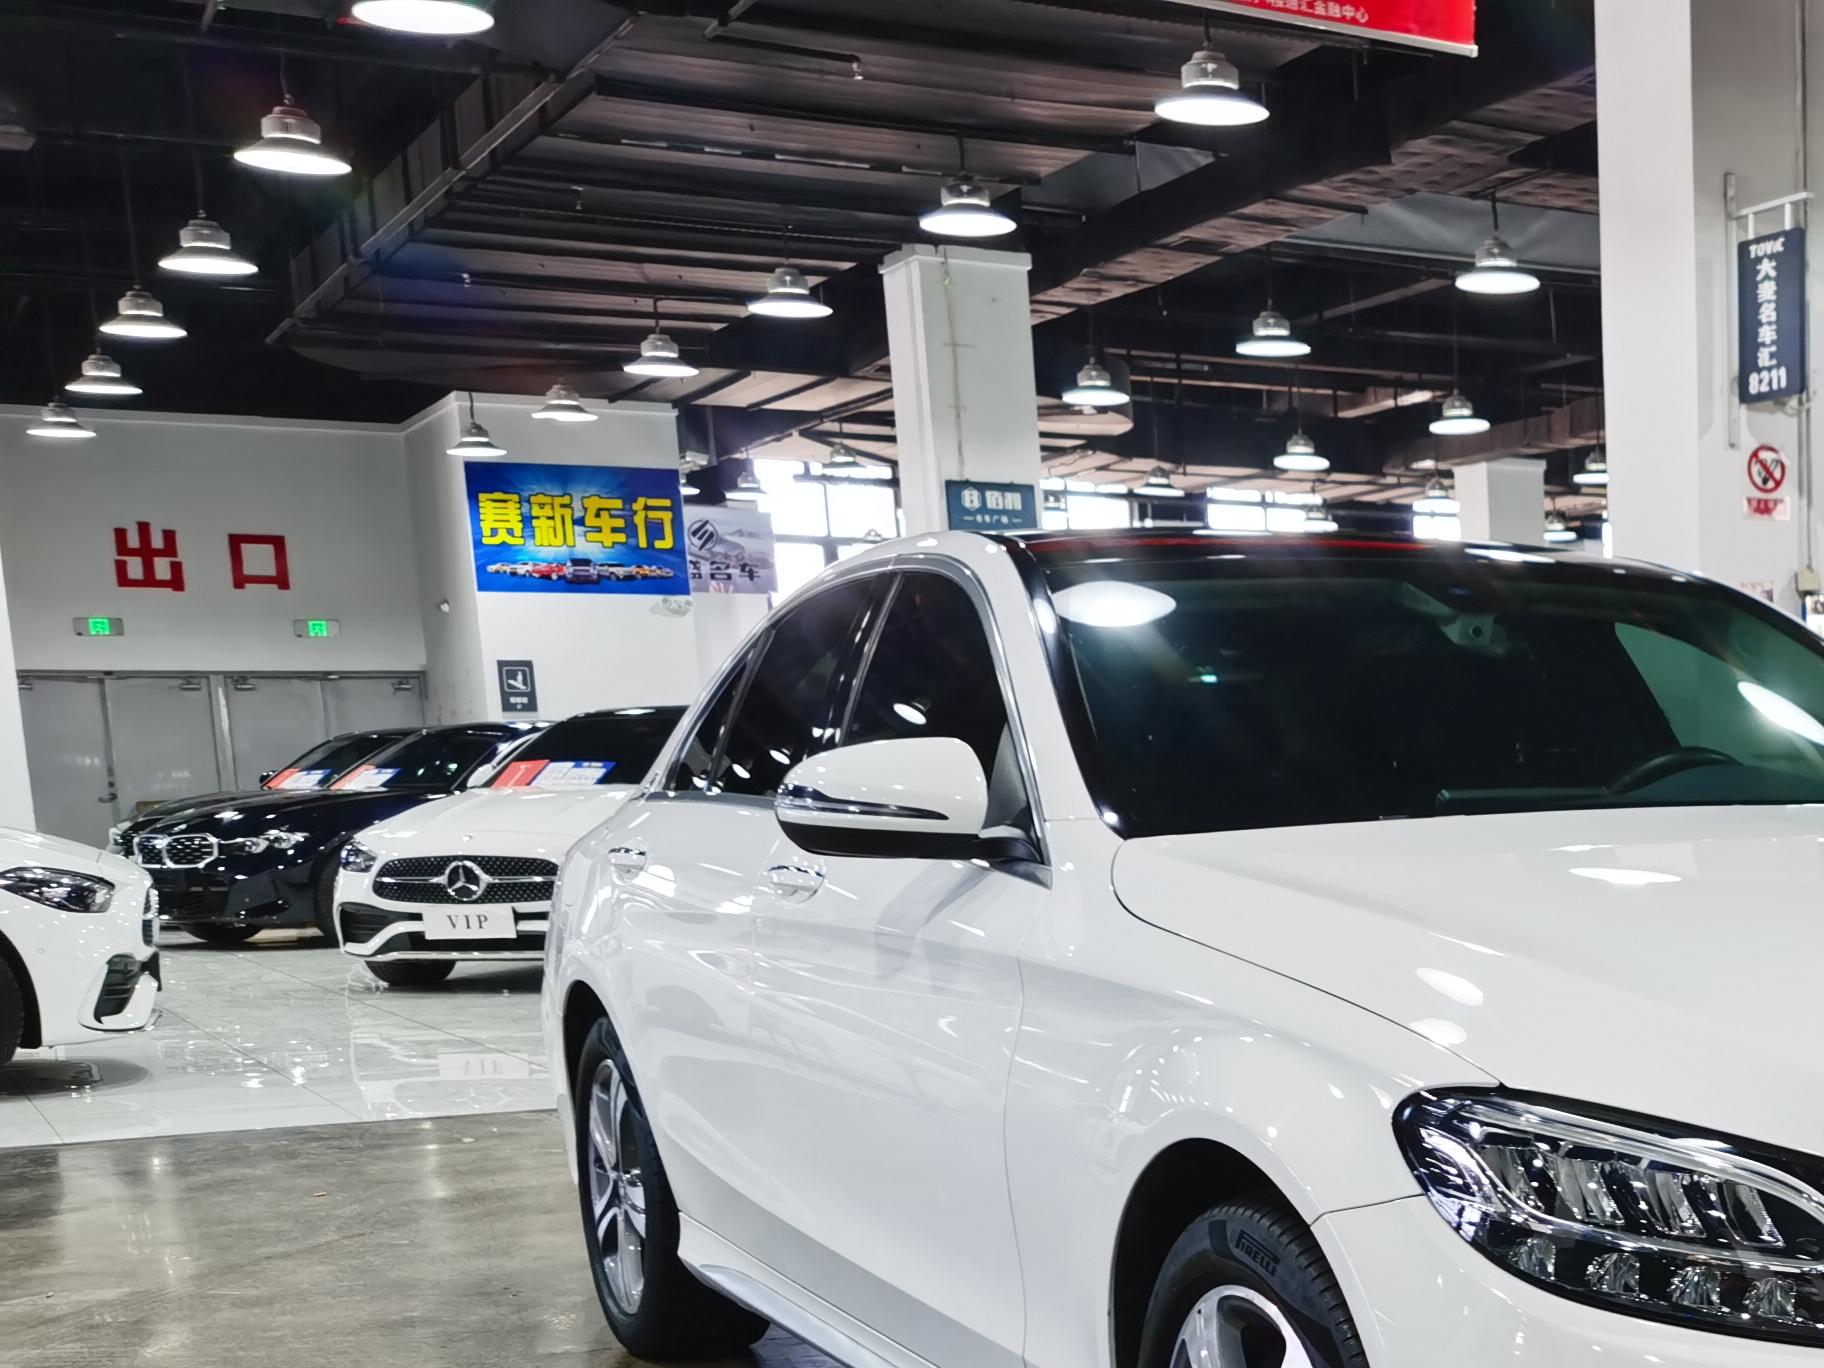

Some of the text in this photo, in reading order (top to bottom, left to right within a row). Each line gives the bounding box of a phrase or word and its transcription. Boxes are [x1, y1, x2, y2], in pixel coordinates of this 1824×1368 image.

[1756, 257, 1778, 368] 大麦名车汇
[1748, 366, 1788, 394] 8211
[477, 491, 675, 550] 赛新车行
[113, 521, 290, 592] 出口
[446, 914, 488, 929] VIP
[1235, 1229, 1281, 1278] PIRELLI
